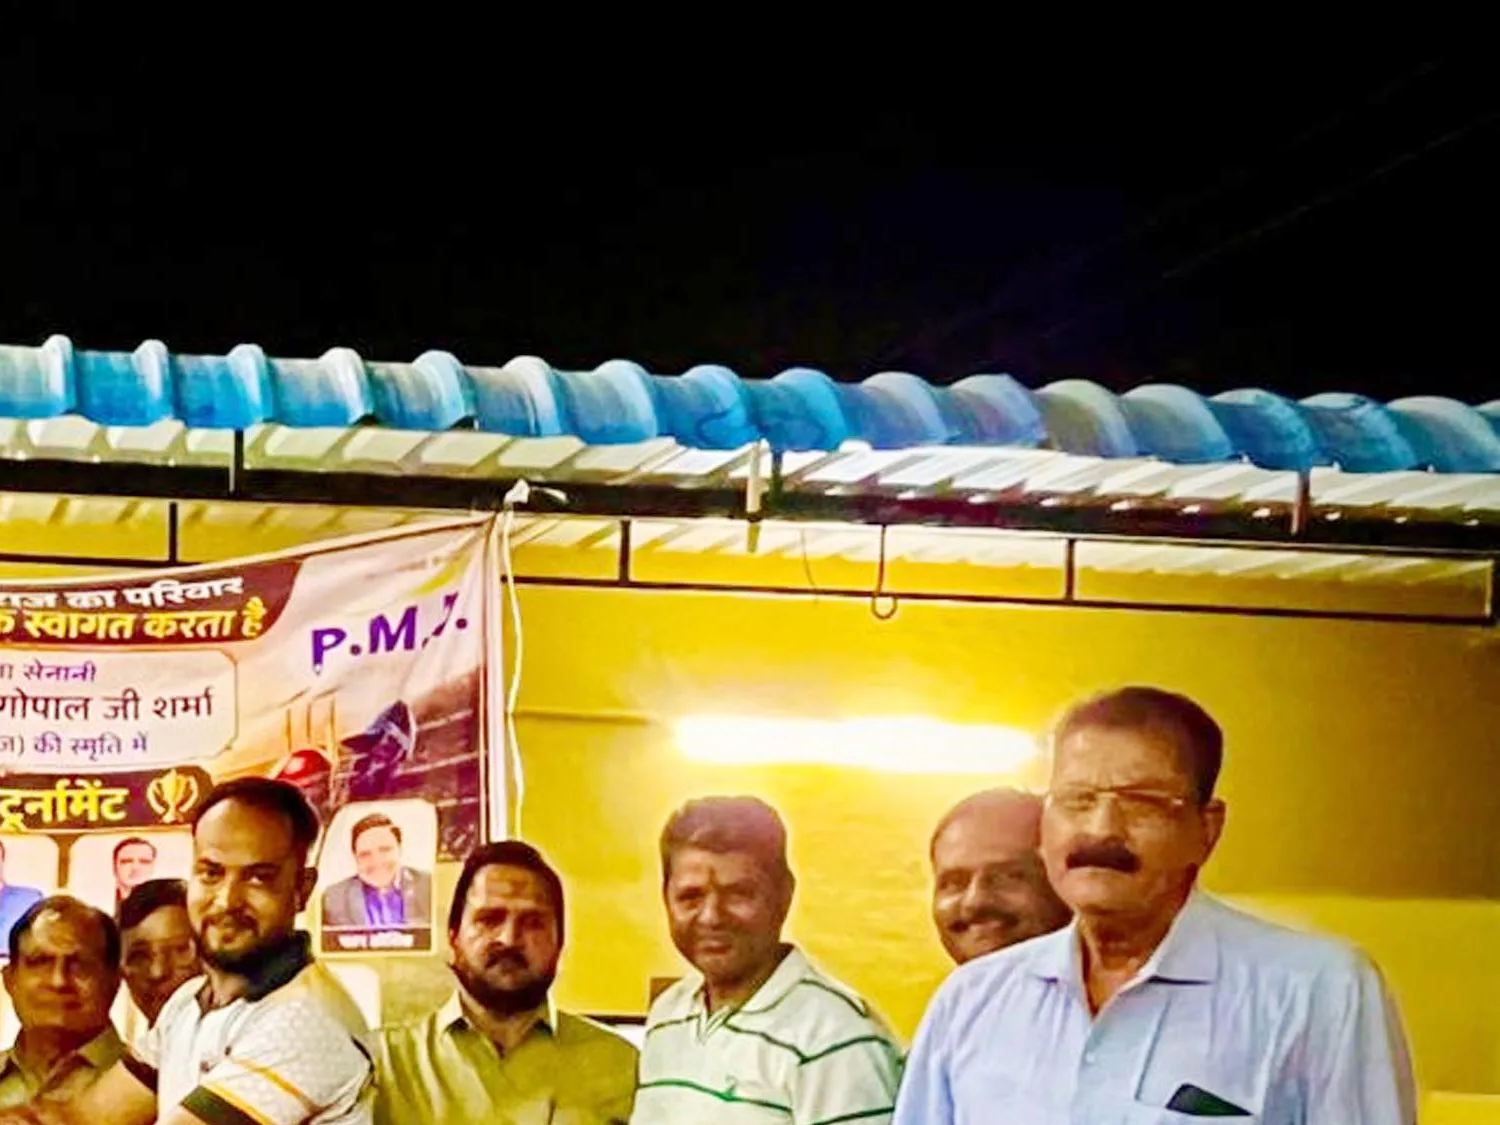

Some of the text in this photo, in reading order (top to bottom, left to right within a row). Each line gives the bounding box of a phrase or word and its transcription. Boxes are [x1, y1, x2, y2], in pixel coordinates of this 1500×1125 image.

[63, 589, 117, 609] का
[122, 576, 244, 608] परिवार
[23, 608, 138, 640] स्वागत
[142, 610, 239, 640] करता
[241, 596, 268, 641] है
[23, 658, 97, 682] सेनानी
[102, 687, 142, 721] जी
[152, 686, 214, 719] शर्मा
[33, 730, 62, 755] की
[70, 731, 122, 762] स्मृति
[131, 729, 149, 752] में
